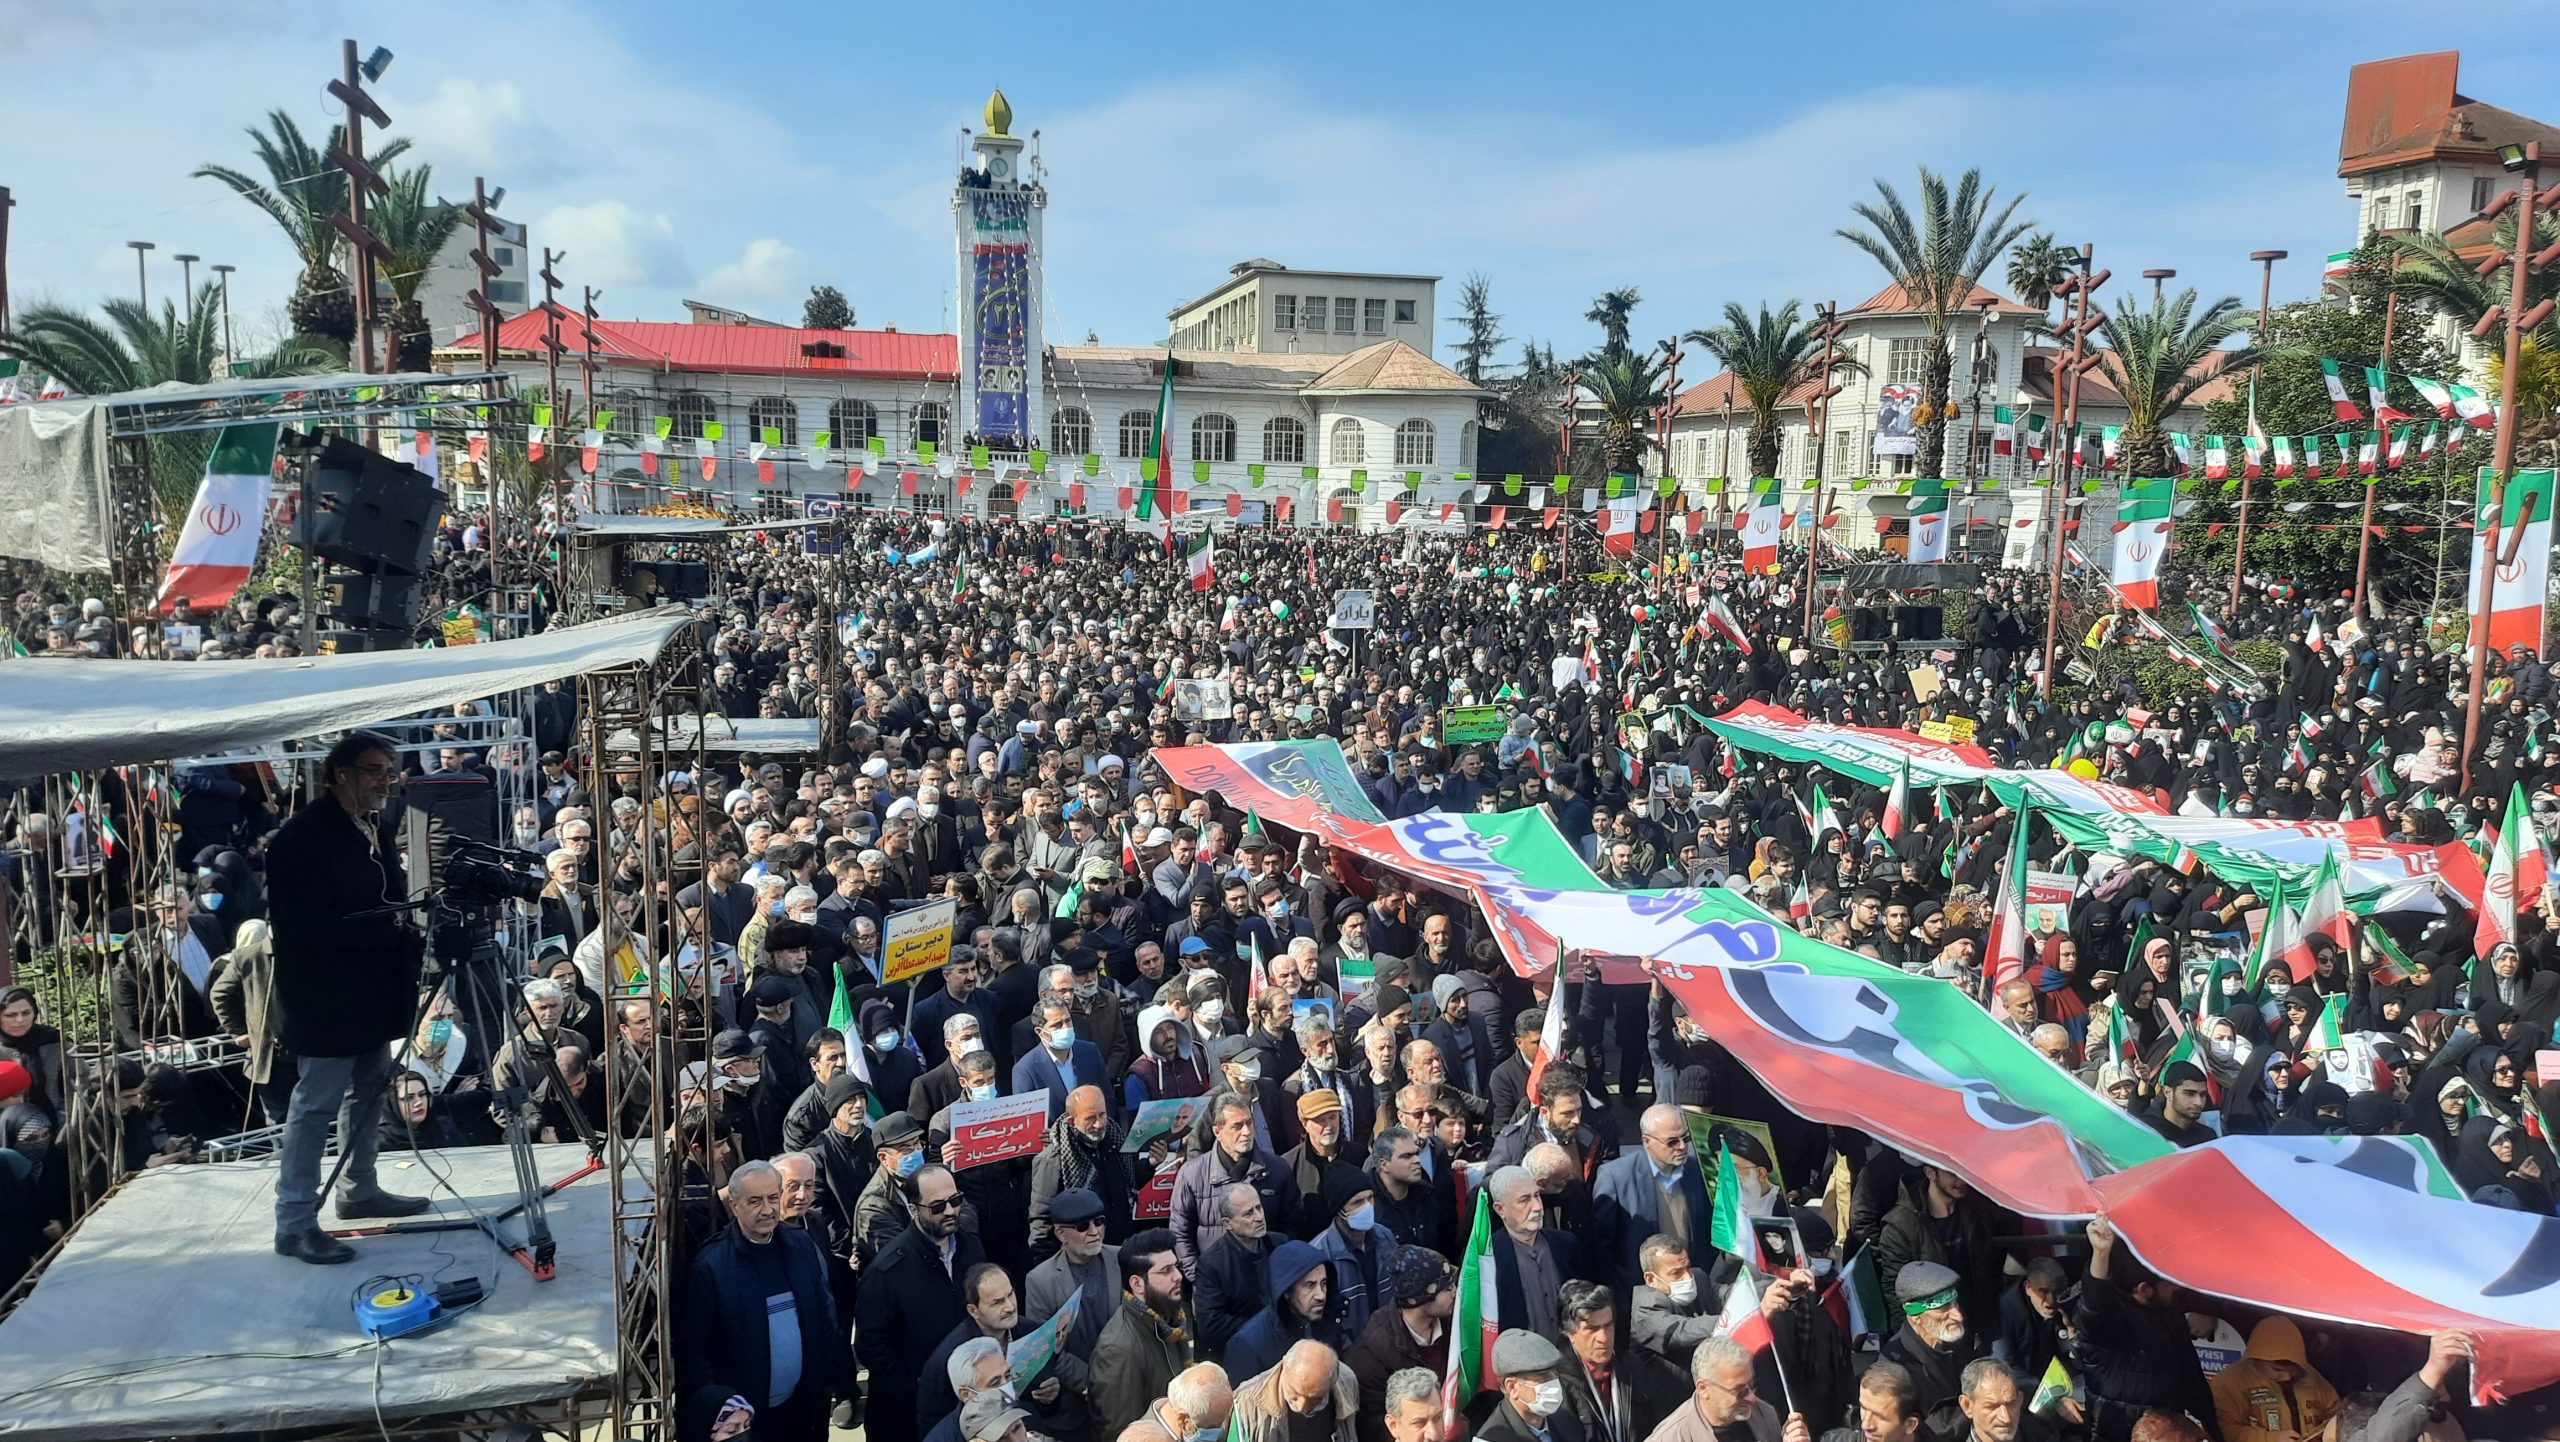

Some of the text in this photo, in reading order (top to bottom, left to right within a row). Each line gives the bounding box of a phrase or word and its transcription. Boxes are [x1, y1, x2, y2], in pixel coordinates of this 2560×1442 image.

[1337, 604, 1370, 621] یاران
[2025, 887, 2061, 902] آمریک
[894, 932, 944, 958] دبیرستان
[969, 1115, 1031, 1140] آمریکا
[2197, 1349, 2224, 1361] ISRA
[2201, 1362, 2231, 1373] OWN
